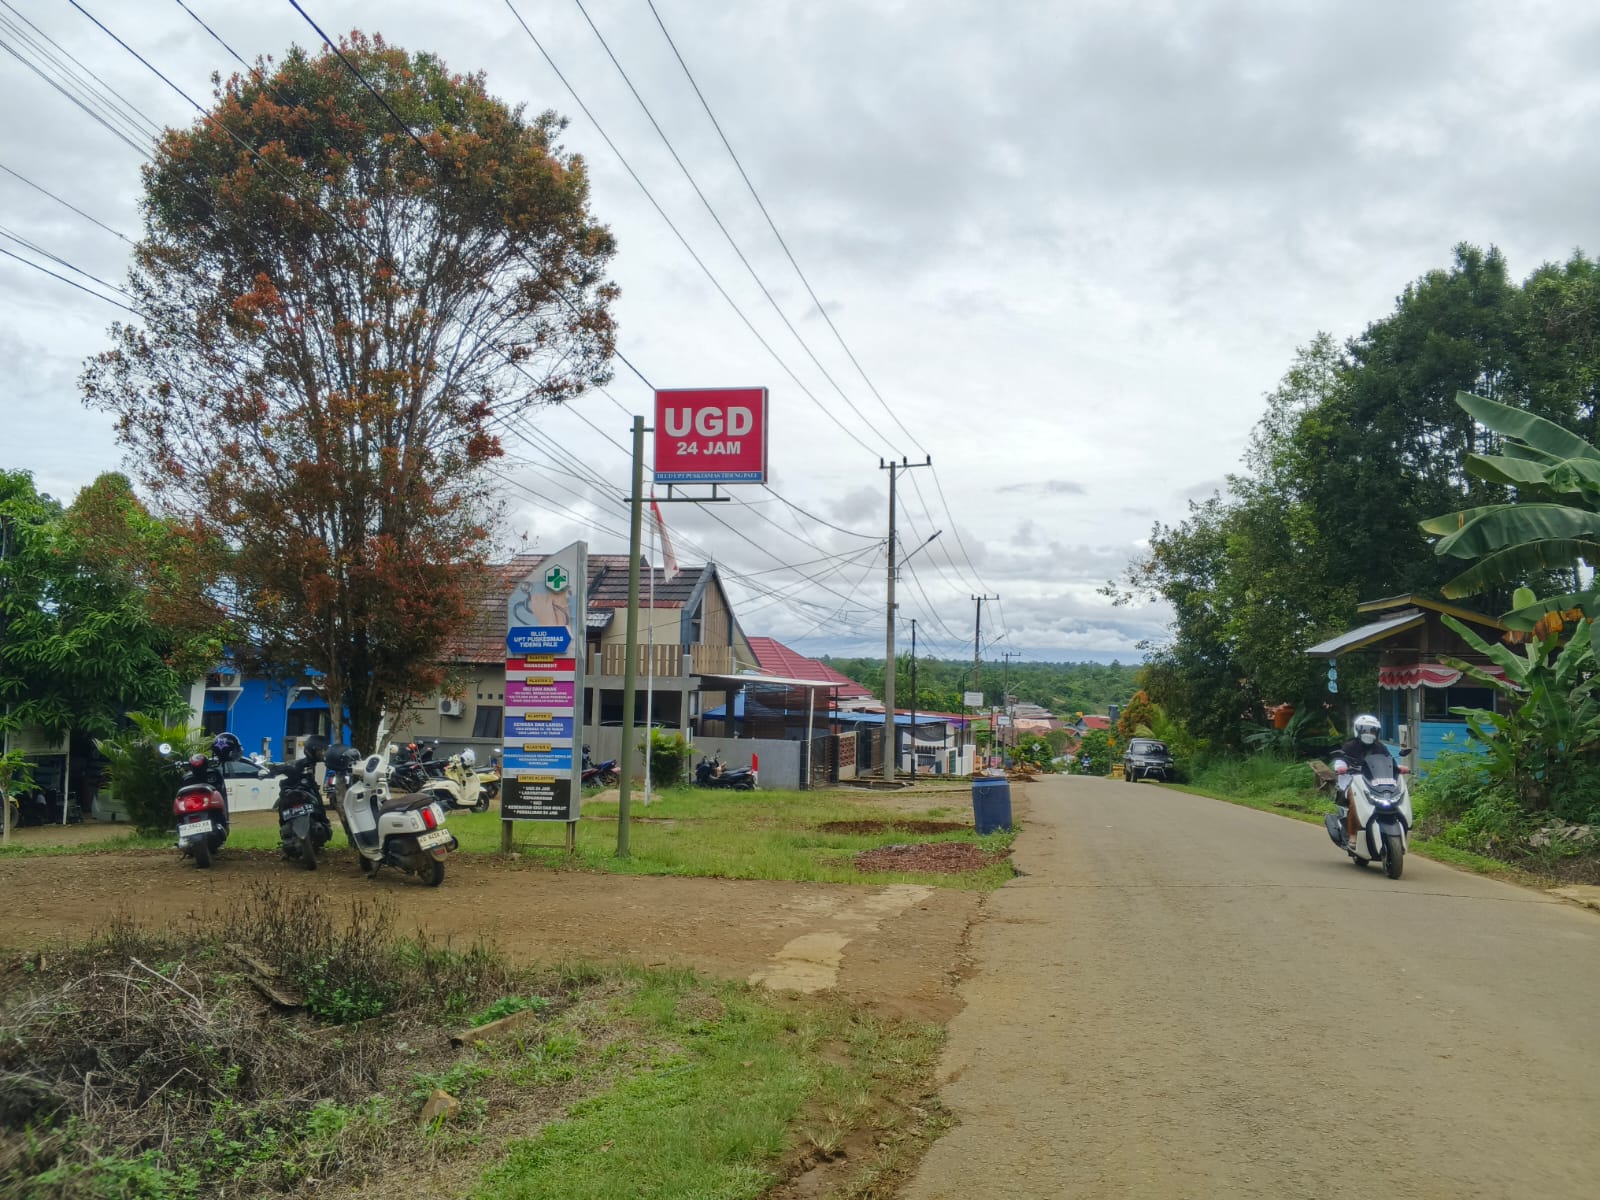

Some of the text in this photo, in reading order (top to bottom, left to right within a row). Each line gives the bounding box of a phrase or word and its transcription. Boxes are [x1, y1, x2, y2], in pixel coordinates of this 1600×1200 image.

[664, 406, 753, 437] UGD
[676, 441, 741, 455] 24 JAM
